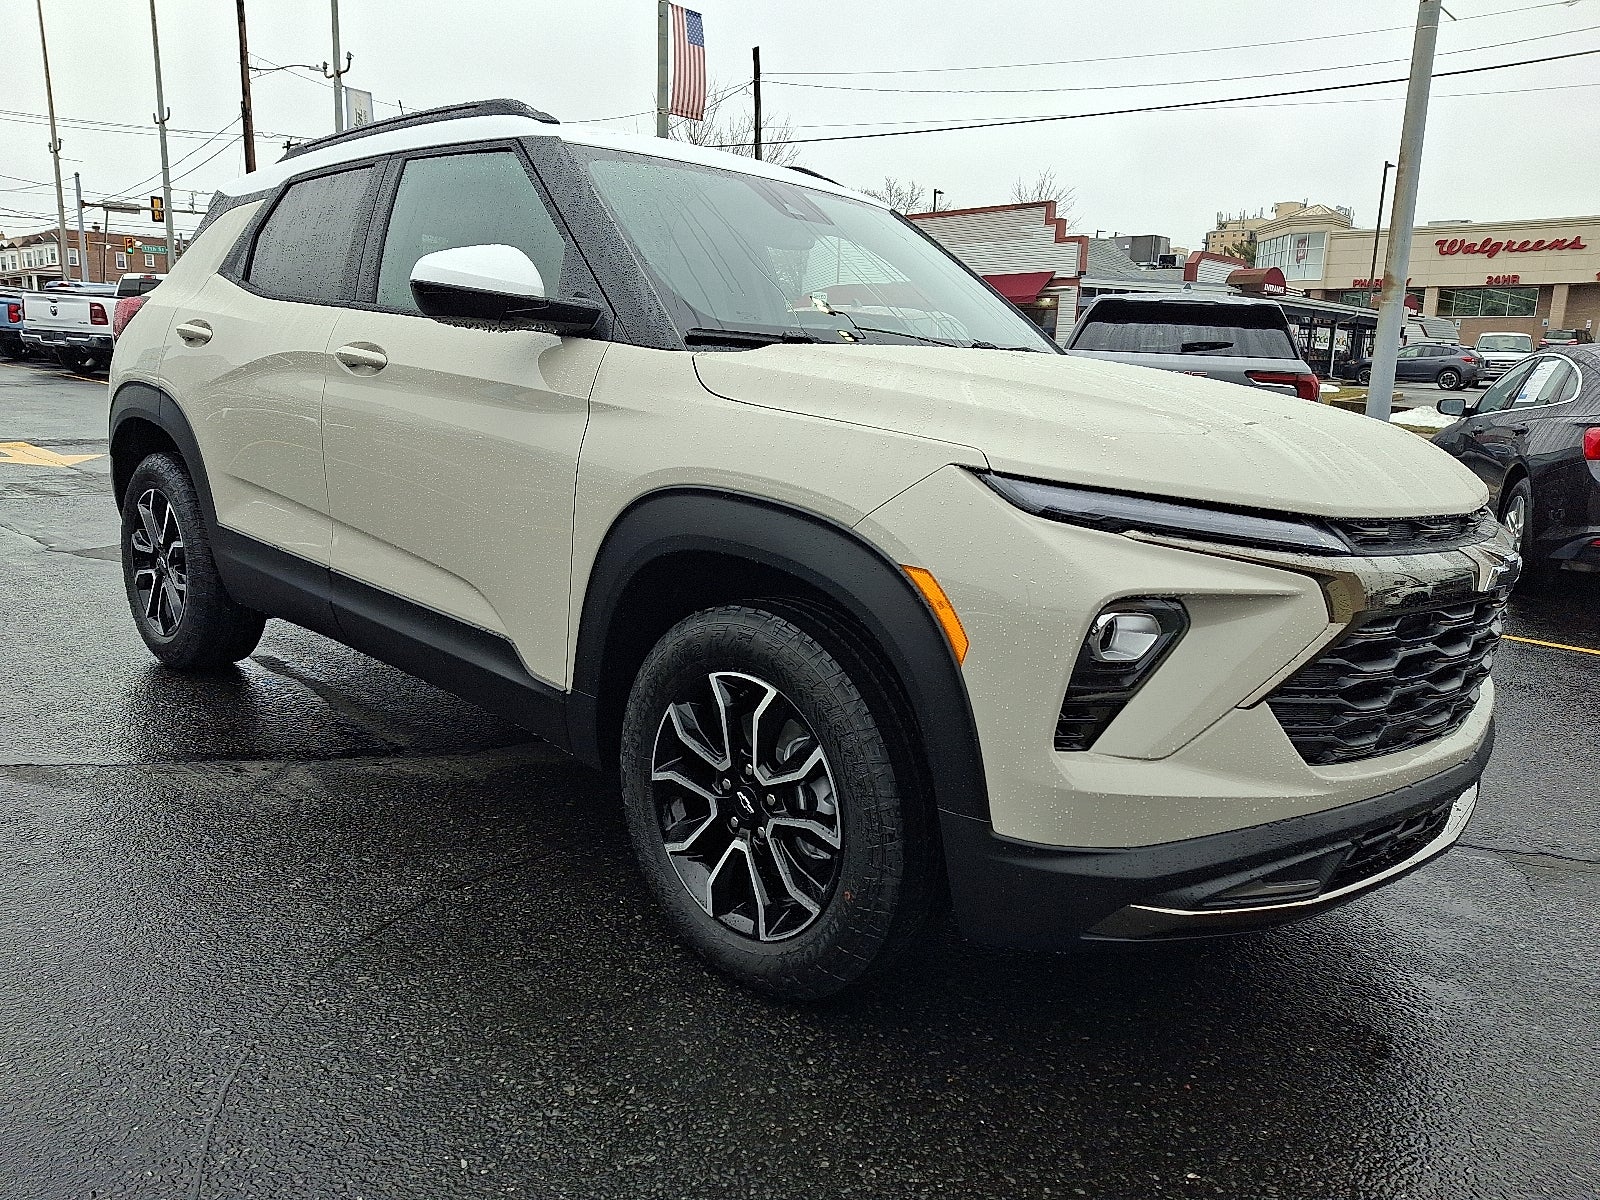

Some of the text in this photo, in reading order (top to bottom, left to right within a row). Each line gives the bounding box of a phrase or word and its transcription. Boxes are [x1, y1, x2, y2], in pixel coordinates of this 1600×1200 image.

[1435, 236, 1587, 258] Walgreens
[1486, 275, 1520, 285] 24HR
[1264, 283, 1285, 294] ENTRANCE
